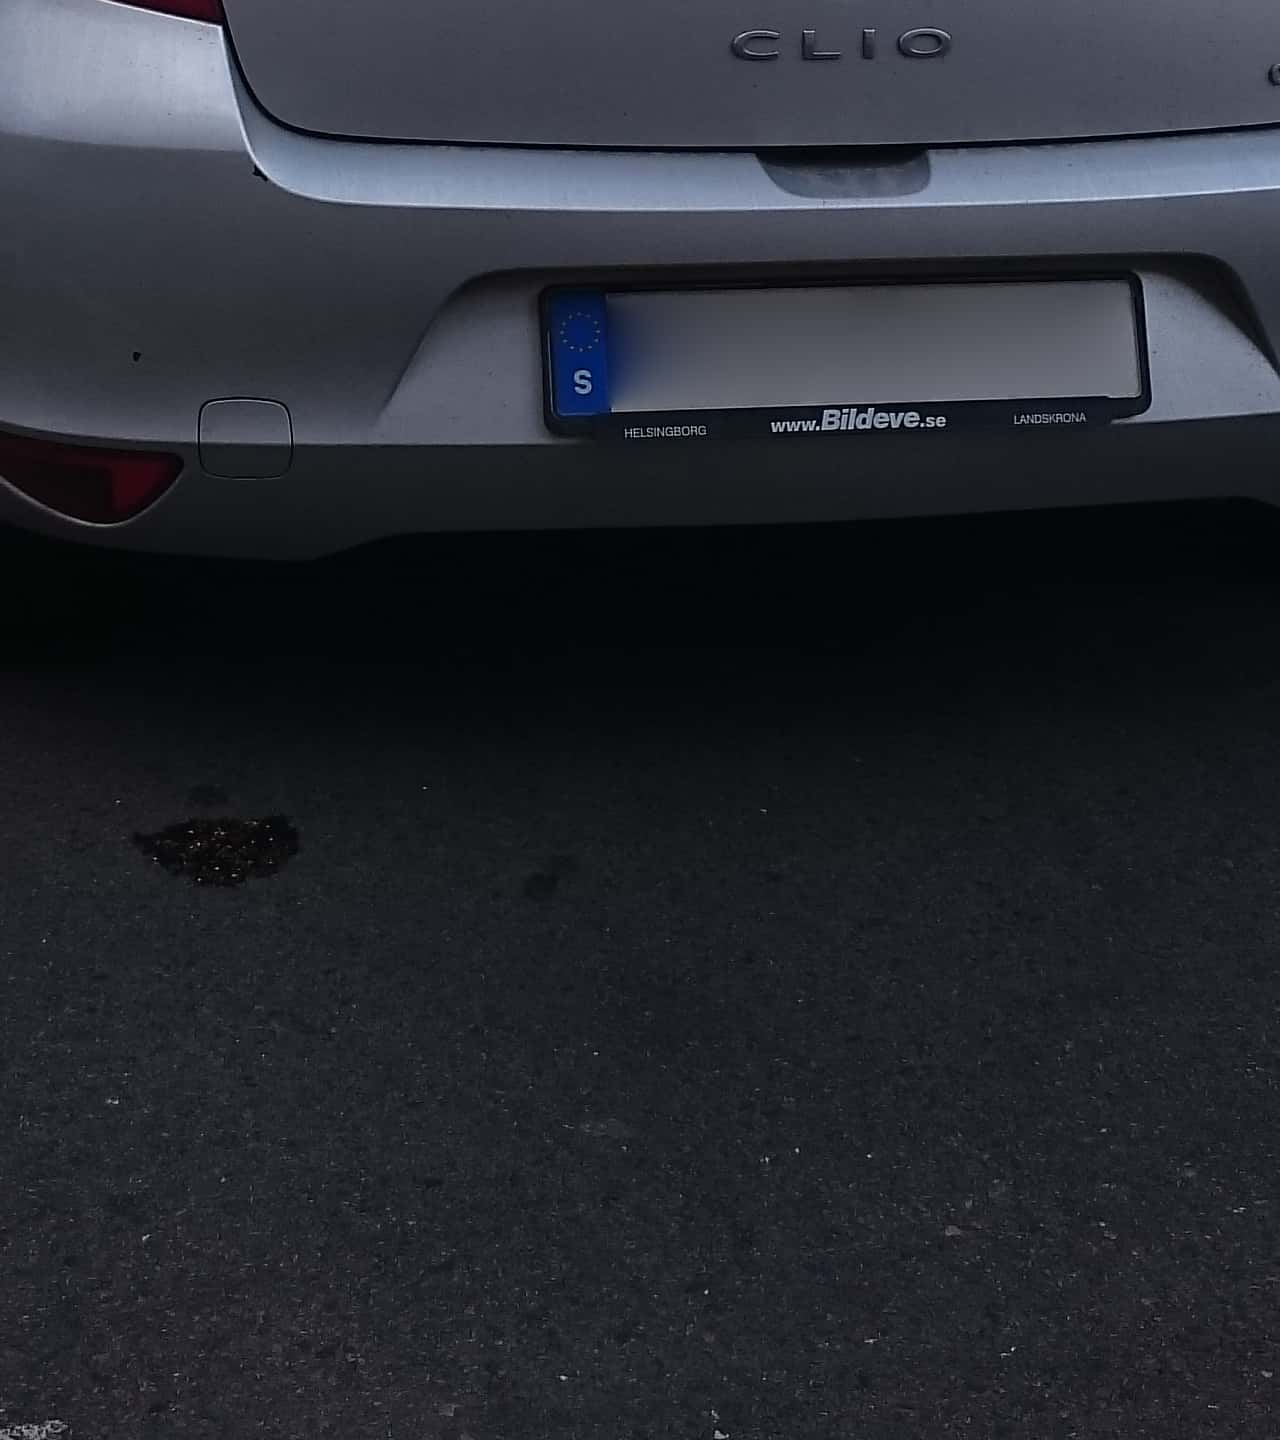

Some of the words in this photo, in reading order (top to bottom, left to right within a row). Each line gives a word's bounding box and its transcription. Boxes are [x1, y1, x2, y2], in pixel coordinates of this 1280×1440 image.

[730, 26, 953, 62] CLIO
[573, 369, 593, 396] S
[623, 425, 708, 439] HELSINGBORG
[770, 408, 947, 435] www.Bildeve.se
[1012, 412, 1087, 426] LANDSKRONA
